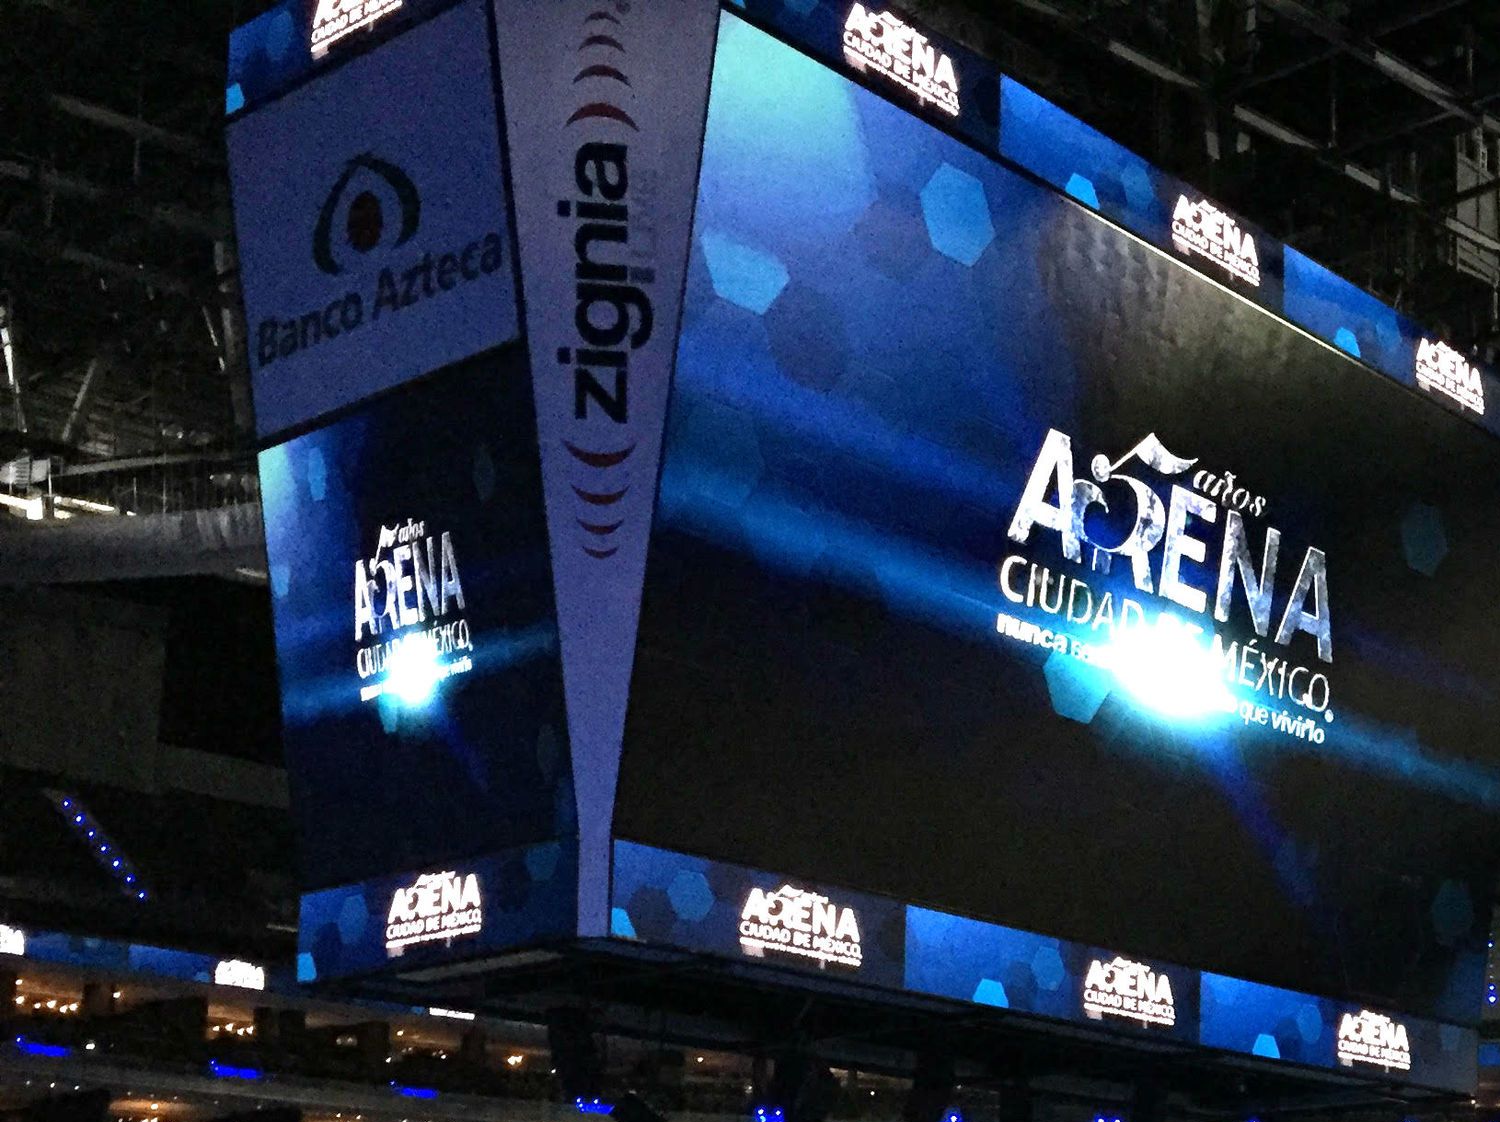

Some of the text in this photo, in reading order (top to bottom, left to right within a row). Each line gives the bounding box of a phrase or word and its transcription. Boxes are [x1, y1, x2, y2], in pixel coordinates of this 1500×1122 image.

[844, 2, 958, 93] ARENA
[1172, 194, 1259, 267] ARENA
[256, 230, 503, 367] Banco Azteca
[558, 141, 654, 424] zignia
[1416, 337, 1483, 397] ARENA
[1193, 468, 1267, 517] años
[1007, 428, 1333, 664] ARENA
[354, 530, 466, 643] ARENA
[1000, 555, 1145, 640] CIUDAD
[996, 612, 1069, 655] nunca
[1238, 701, 1325, 744] que vivirlo
[387, 873, 481, 925] ARENA
[741, 887, 860, 943] ARENA
[740, 920, 792, 943] CIUDAD
[792, 930, 812, 948] DE
[1084, 959, 1174, 1005] ARENA
[1338, 1012, 1410, 1052] ARENA
